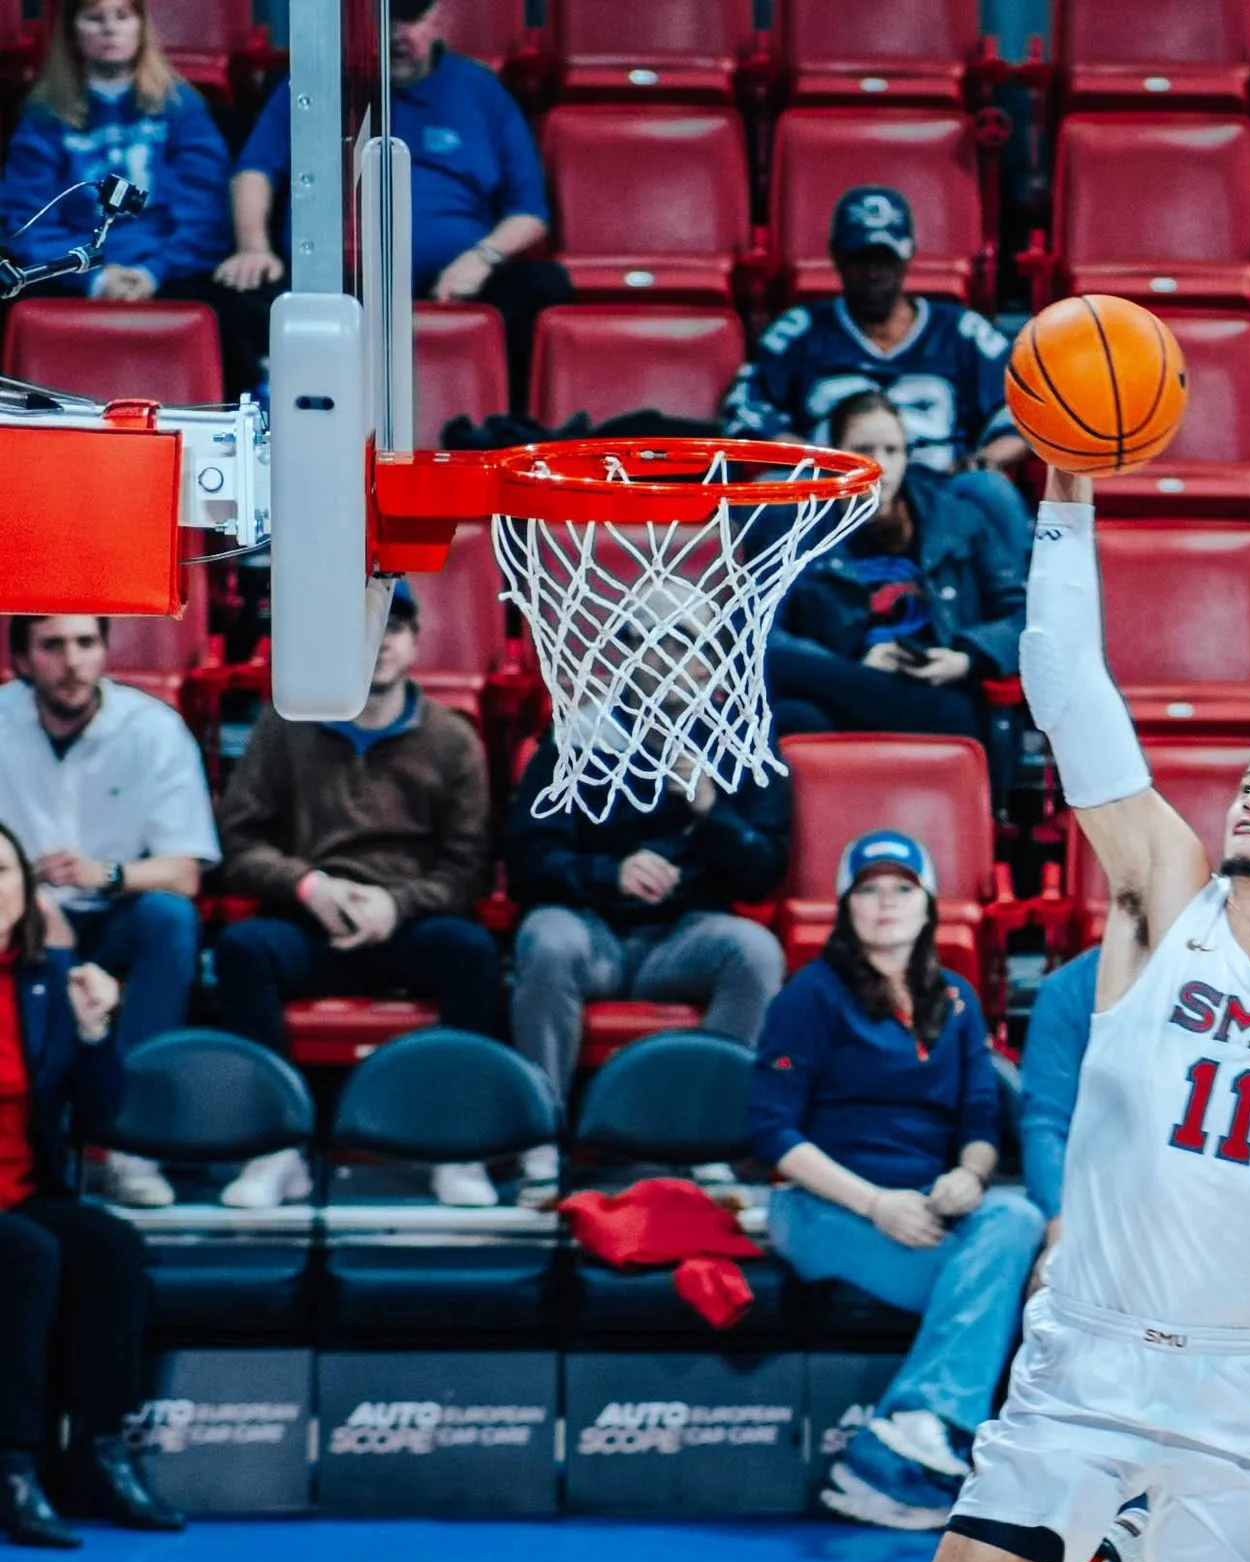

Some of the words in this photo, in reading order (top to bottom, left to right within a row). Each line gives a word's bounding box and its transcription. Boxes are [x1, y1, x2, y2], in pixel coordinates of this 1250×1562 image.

[1143, 1328, 1188, 1348] SMU
[125, 1399, 195, 1425] UTO
[348, 1402, 441, 1427] AUTO
[595, 1402, 688, 1427] AUTO
